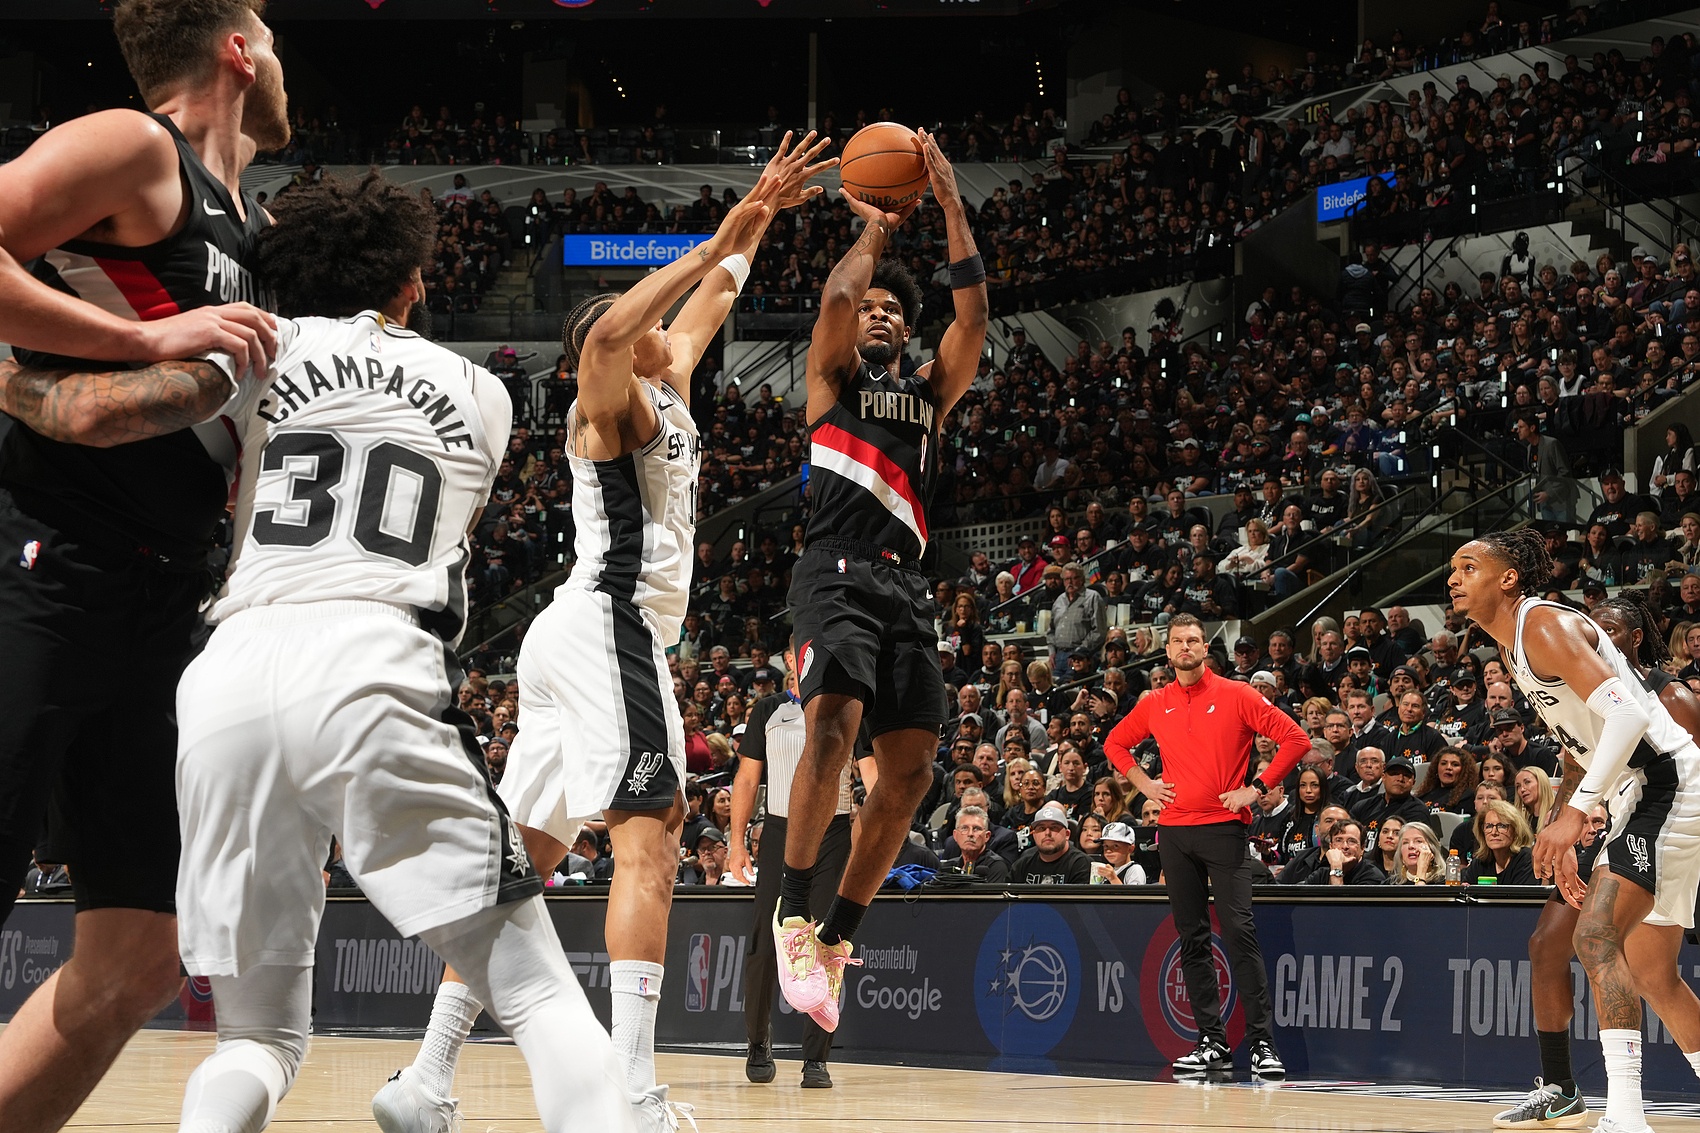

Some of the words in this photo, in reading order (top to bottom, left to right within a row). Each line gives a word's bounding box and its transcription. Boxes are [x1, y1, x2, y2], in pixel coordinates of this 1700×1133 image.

[858, 190, 918, 206] Wilson
[590, 239, 695, 260] Bitdefend
[257, 353, 474, 452] CHAMPAGNIE
[858, 390, 934, 435] PORTLAN
[248, 427, 446, 570] 30
[1553, 723, 1589, 757] 4
[859, 944, 905, 970] Presented
[906, 944, 918, 974] by
[857, 974, 942, 1020] Google
[1097, 961, 1125, 1013] VS
[1274, 953, 1373, 1030] GAME
[1380, 956, 1404, 1032] 2
